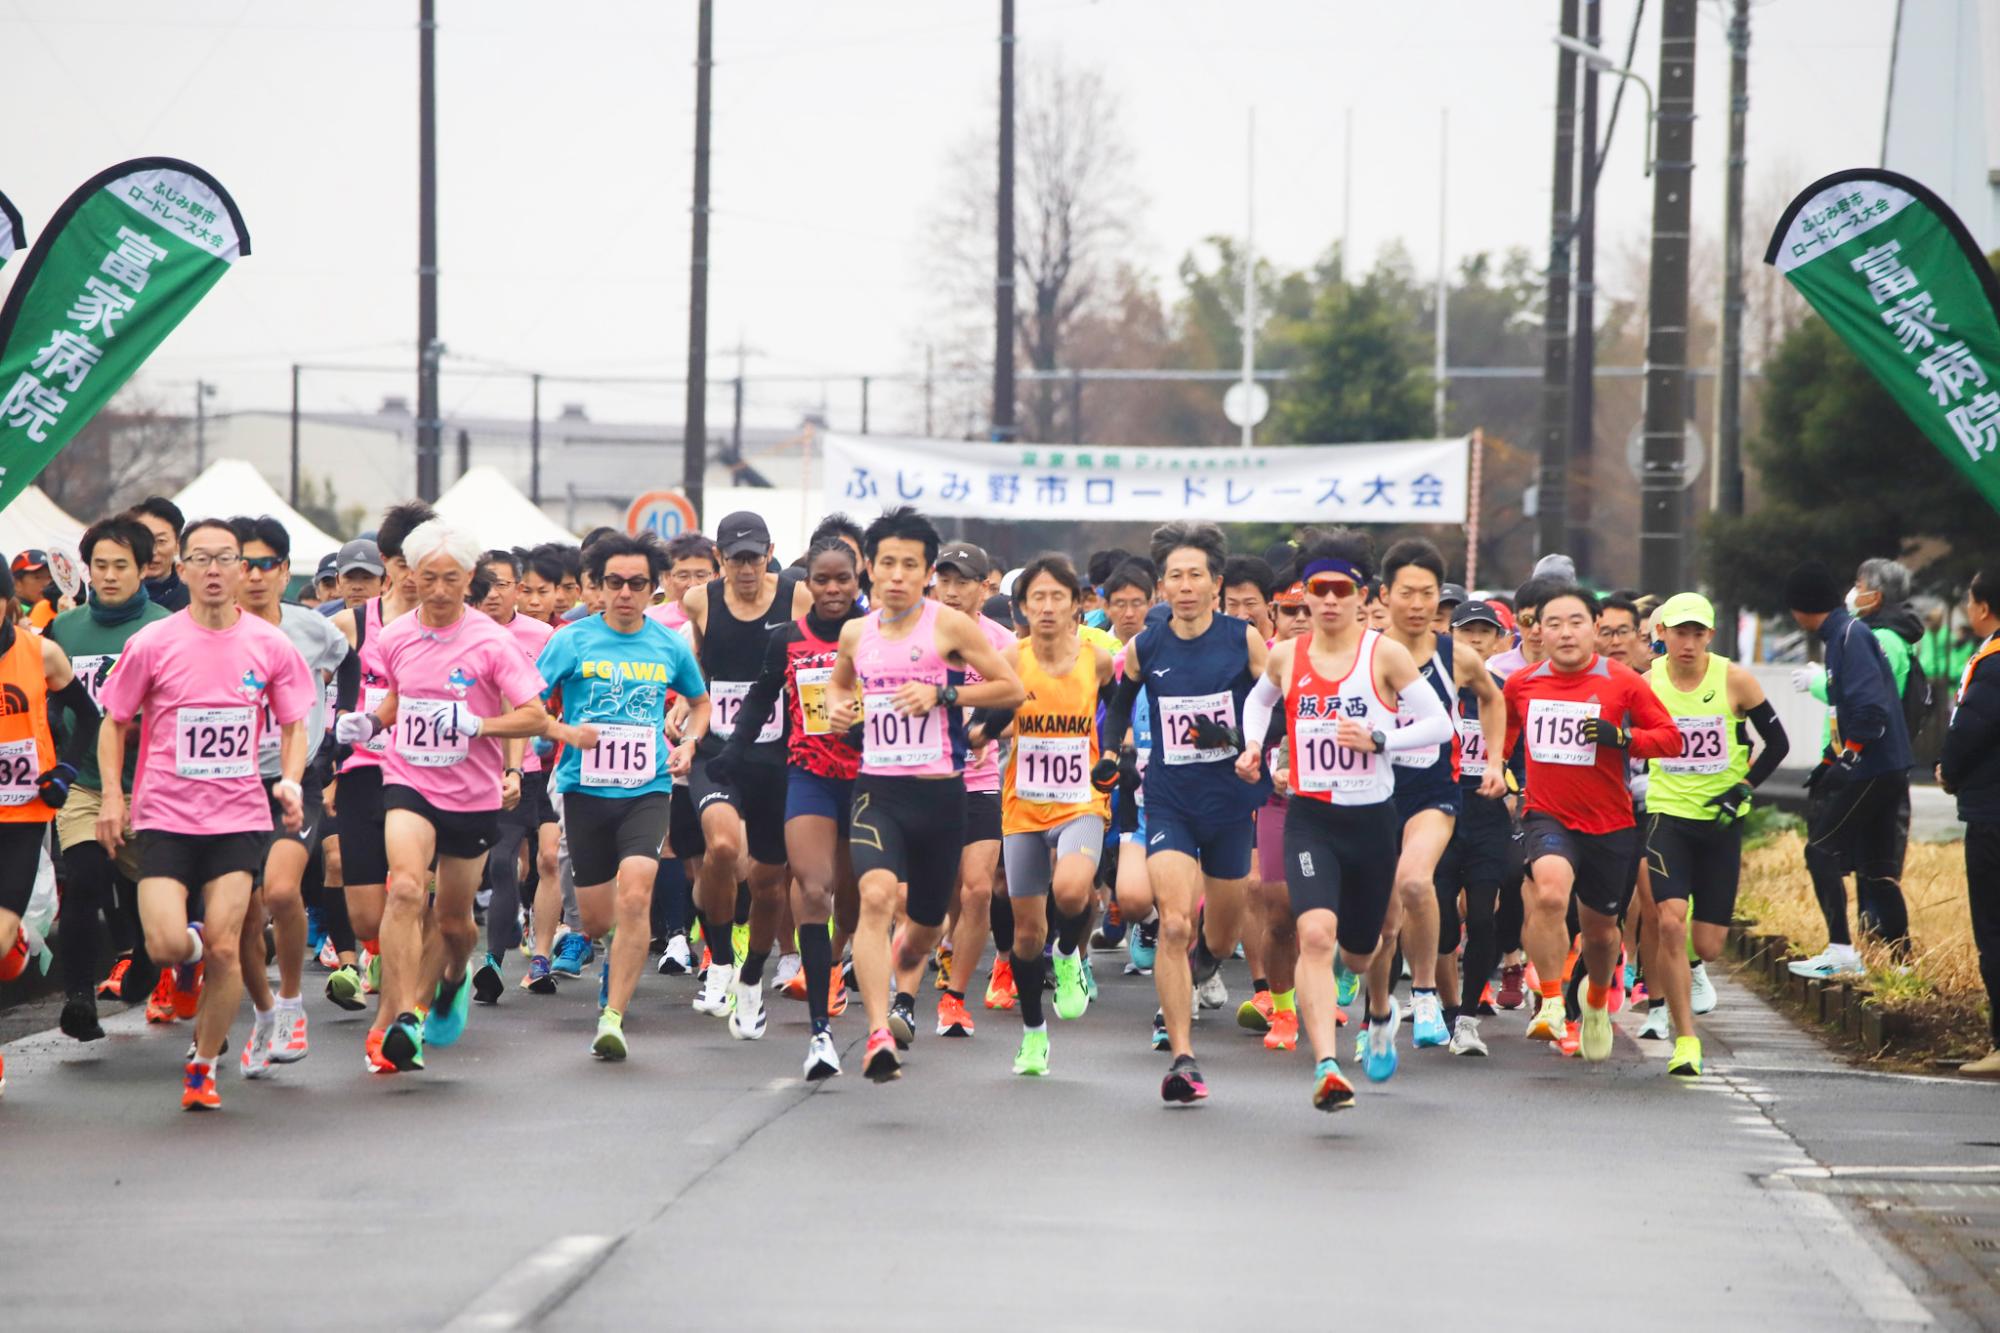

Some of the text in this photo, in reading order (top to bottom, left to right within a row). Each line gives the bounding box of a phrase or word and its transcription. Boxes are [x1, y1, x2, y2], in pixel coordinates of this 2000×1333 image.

[128, 186, 225, 249] ロードレース大会
[153, 181, 217, 225] ふじみ野市
[1801, 191, 1864, 233] ふじみ野市
[1792, 199, 1890, 258] ロードレース大会
[0, 225, 169, 443] 富家病院
[1850, 239, 2000, 462] 富家病院
[846, 468, 1443, 505] ふじみ野市ロードレース大会
[645, 510, 682, 541] 40
[582, 661, 668, 683] EGAWA
[1299, 696, 1368, 718] 坂戸西
[186, 725, 249, 758] 1252
[871, 713, 930, 745] 1017
[1167, 709, 1230, 745] 125
[594, 740, 647, 771] 1115
[1025, 753, 1082, 784] 1105
